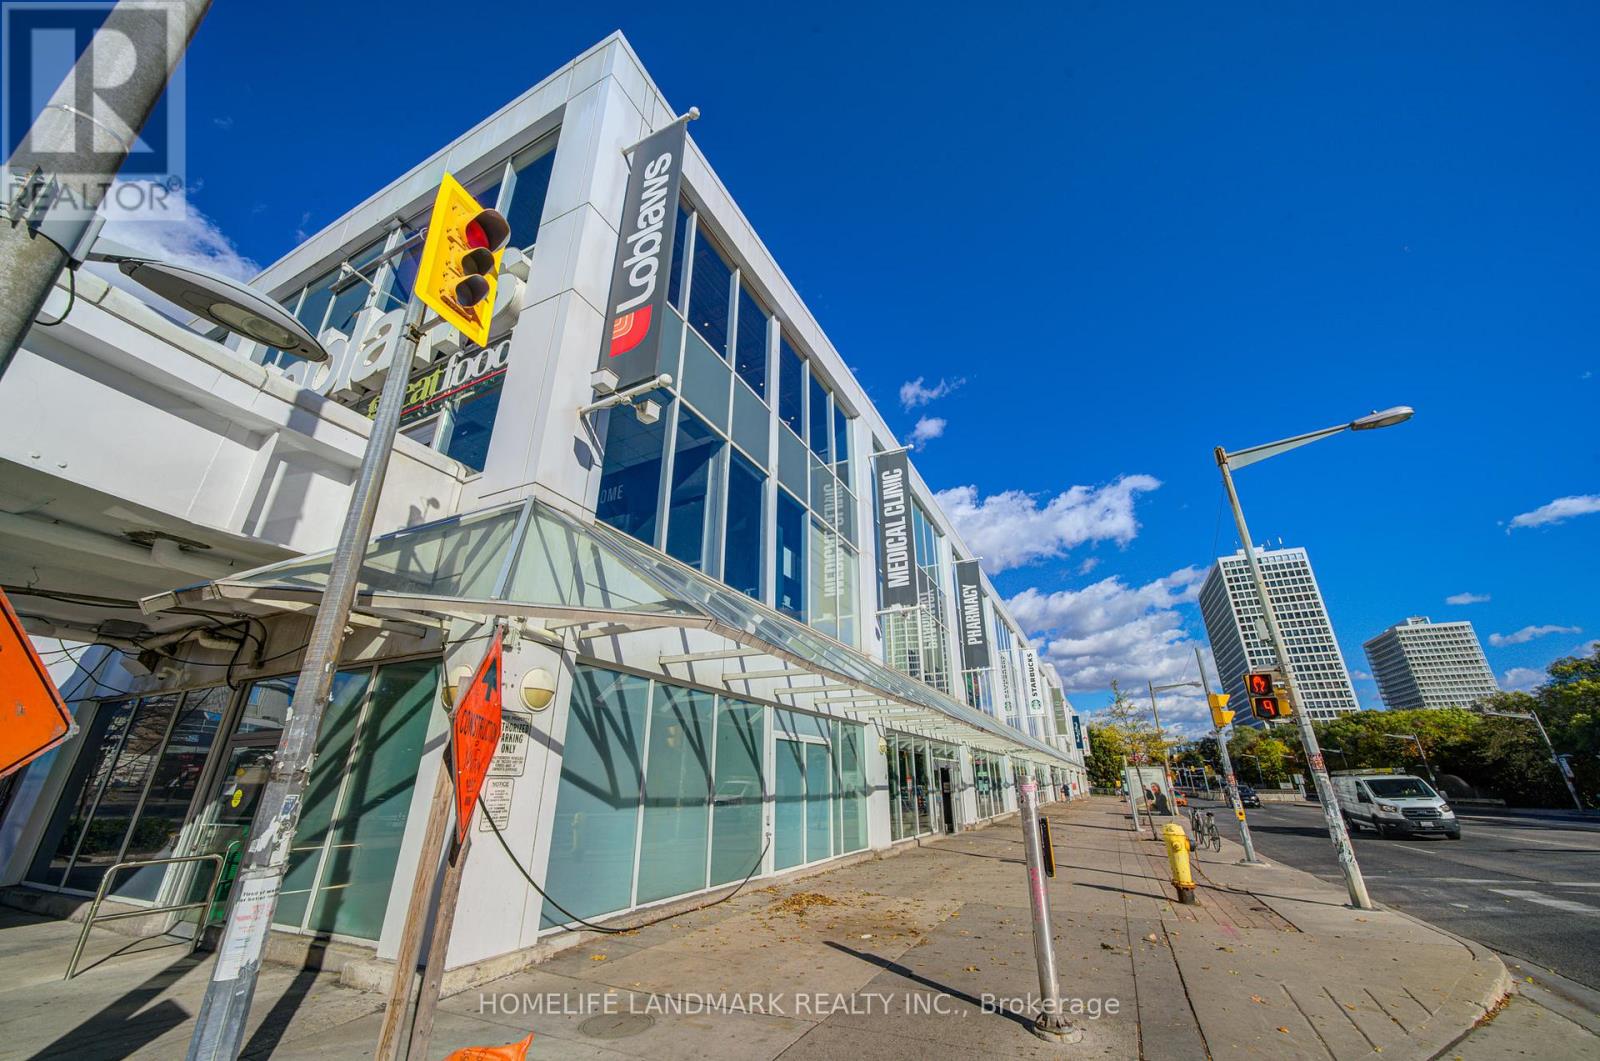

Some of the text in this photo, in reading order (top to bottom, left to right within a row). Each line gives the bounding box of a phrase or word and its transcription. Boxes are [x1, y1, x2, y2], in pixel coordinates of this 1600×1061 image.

[616, 152, 671, 314] Loblaws
[882, 468, 910, 588] MEDICAL CLINIC
[962, 584, 983, 646] PHARMACY
[1027, 652, 1038, 697] STARBUCKS
[1263, 700, 1275, 715] 9
[501, 732, 524, 743] ARKING
[501, 744, 516, 753] ONLY
